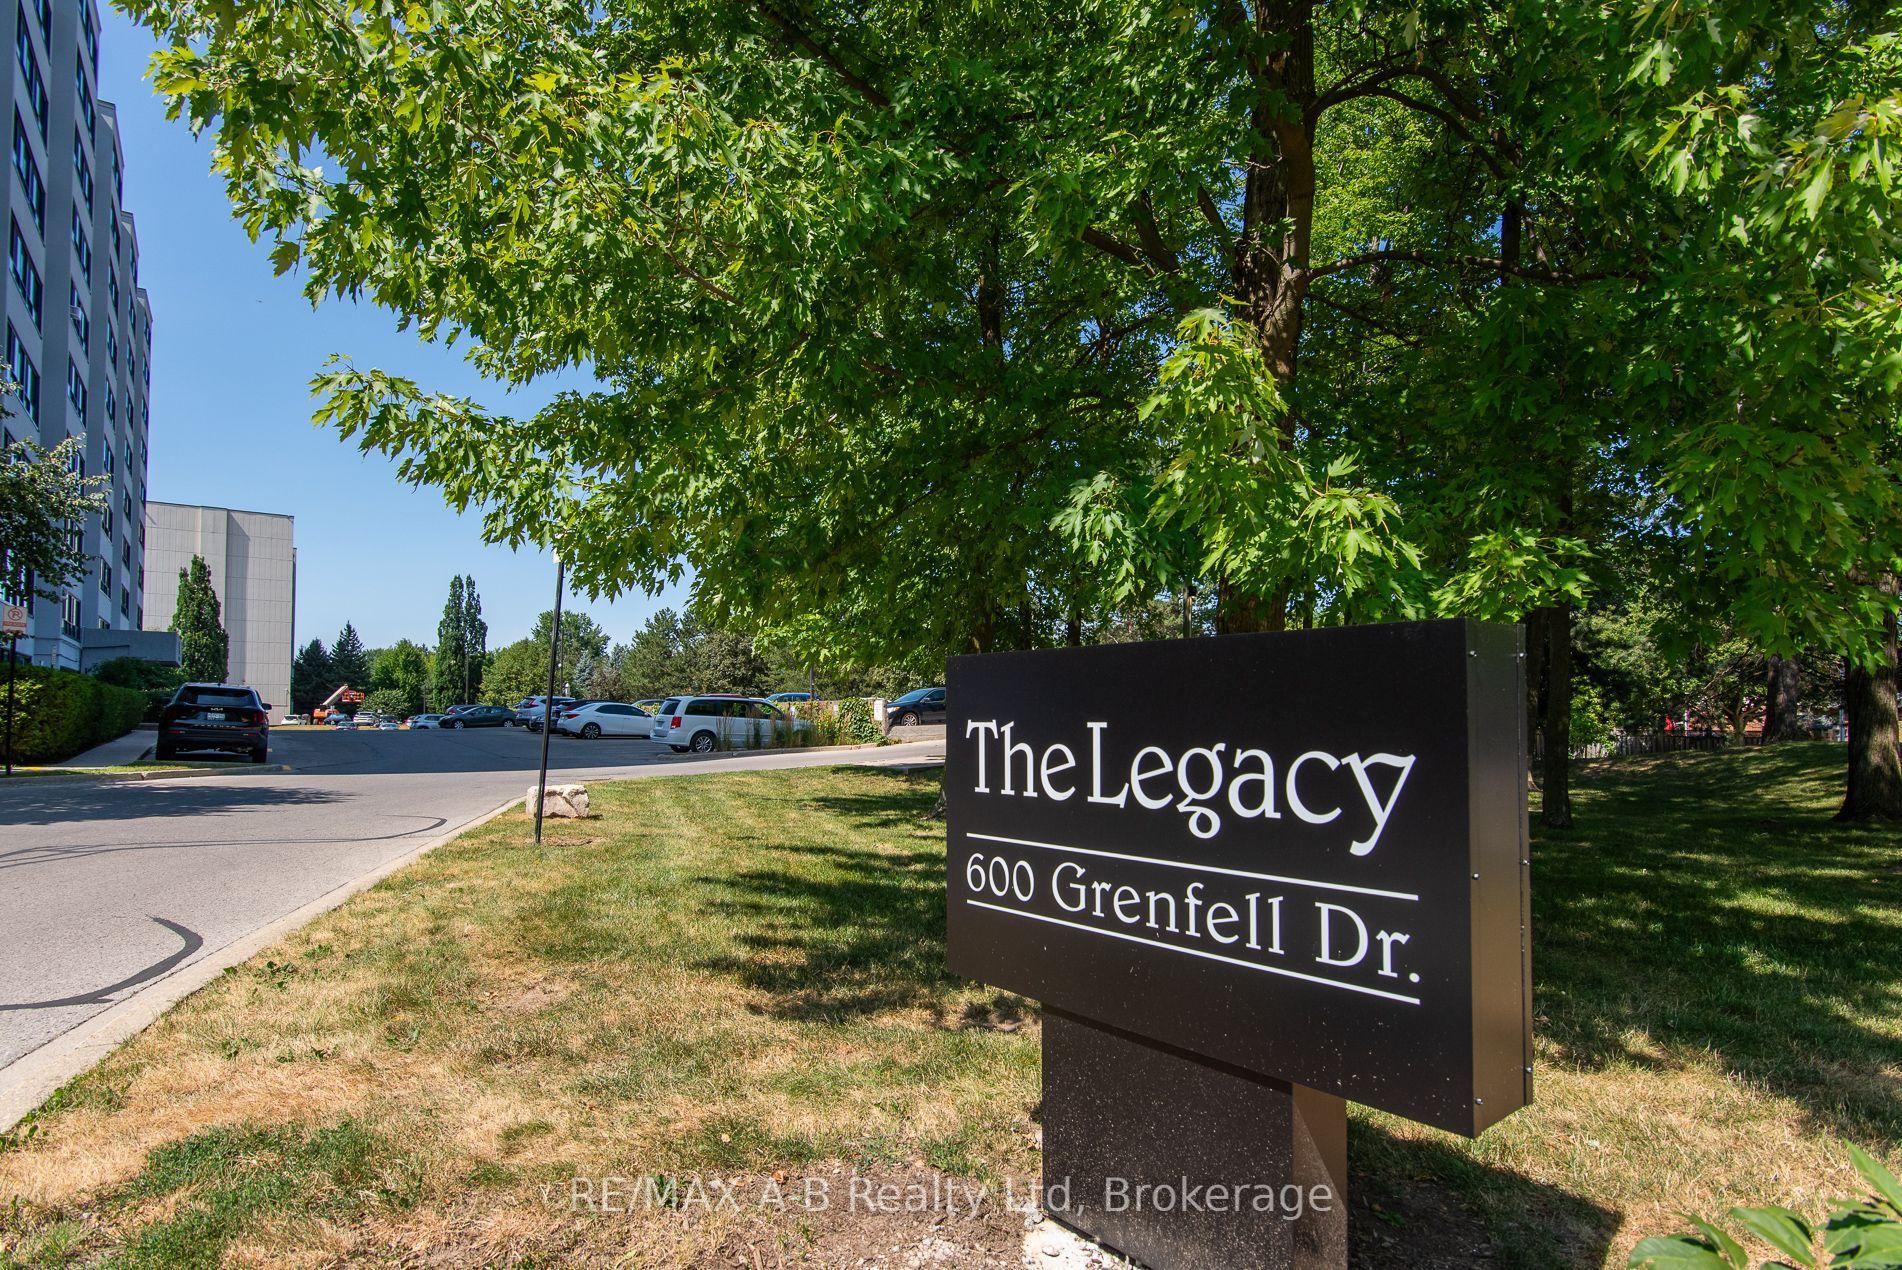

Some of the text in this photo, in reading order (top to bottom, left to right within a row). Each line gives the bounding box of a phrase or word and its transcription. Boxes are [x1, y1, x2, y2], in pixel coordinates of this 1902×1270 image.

[966, 852, 1420, 983] 600 Grenfell Dr.
